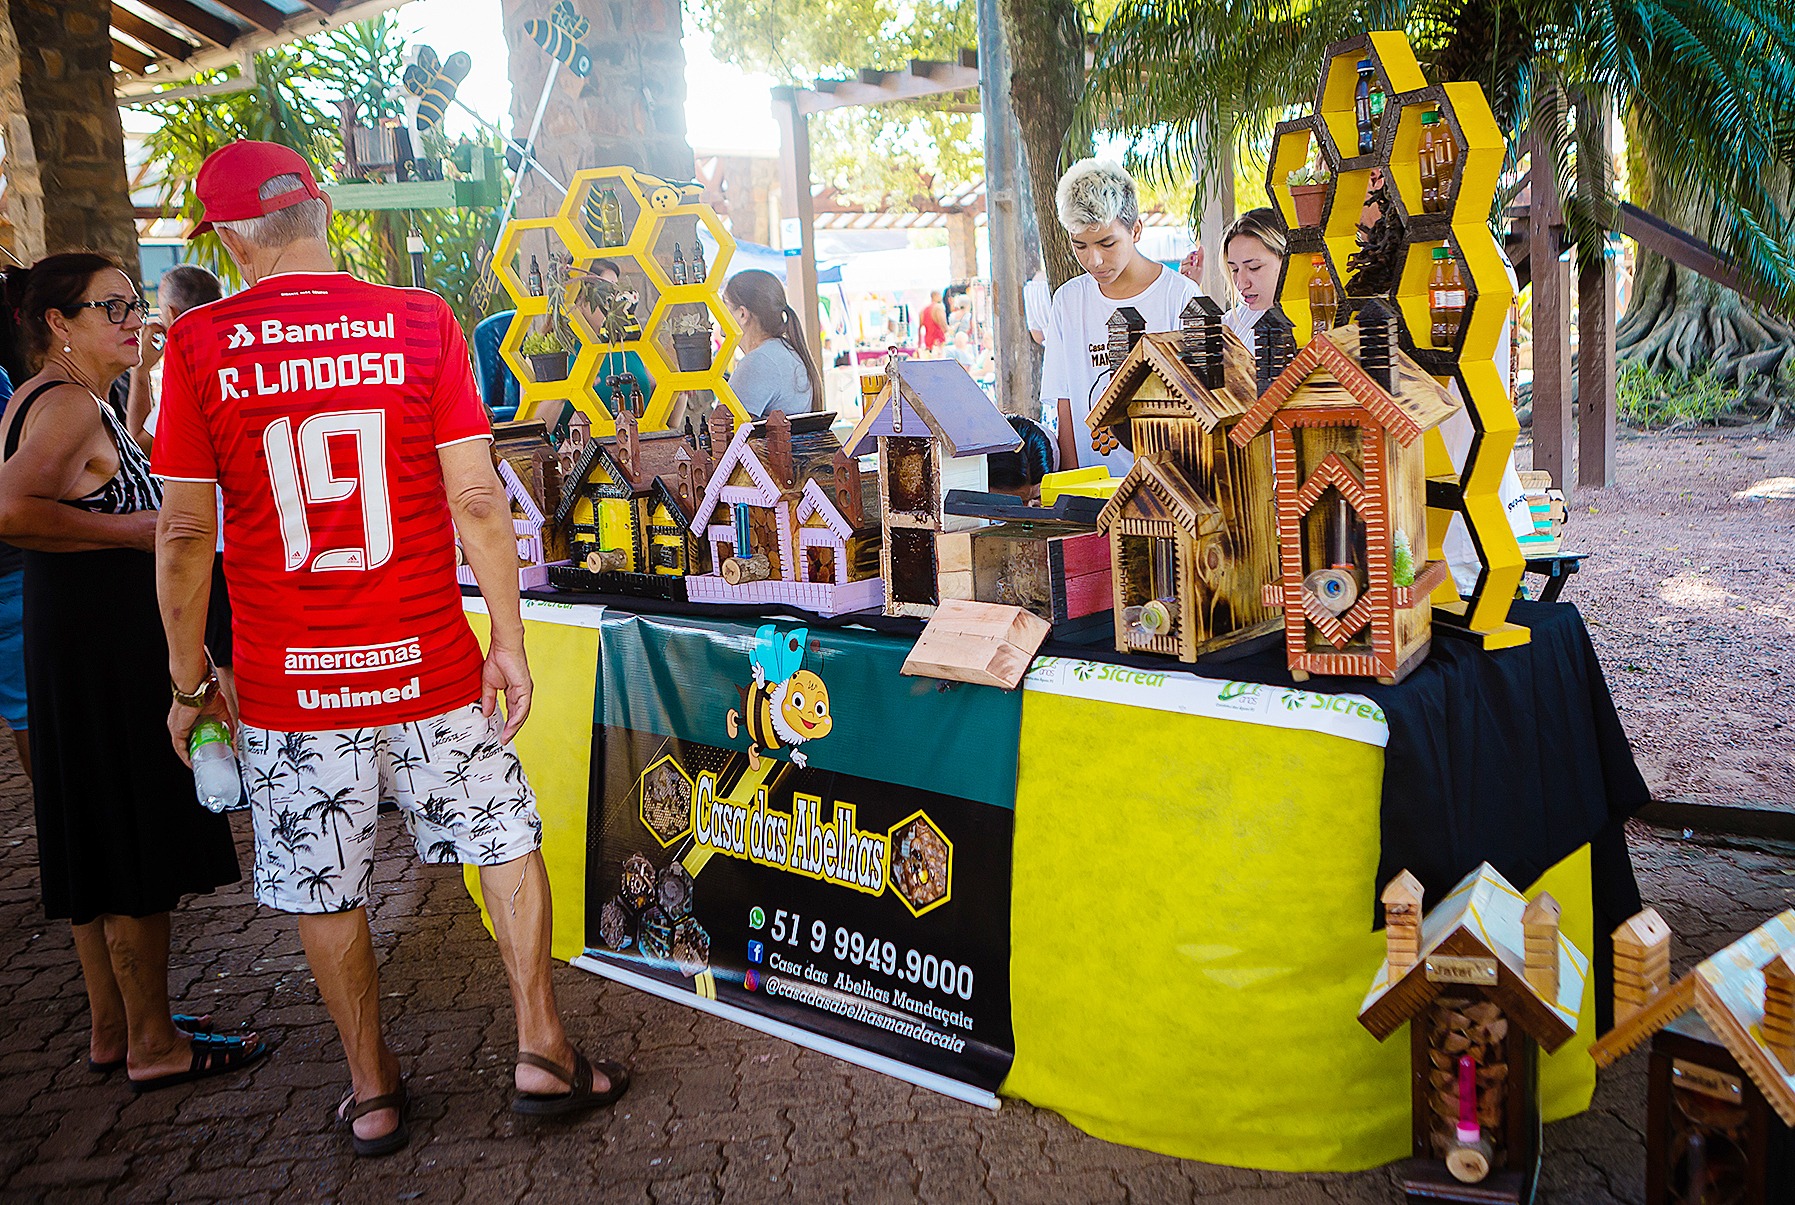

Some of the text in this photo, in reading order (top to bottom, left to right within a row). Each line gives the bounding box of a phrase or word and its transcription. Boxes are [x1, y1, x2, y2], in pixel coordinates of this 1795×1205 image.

[261, 313, 394, 344] Banrisul
[1089, 343, 1105, 352] Casa
[218, 353, 405, 401] R. LINDOSO
[263, 408, 393, 572] 19
[284, 643, 422, 671] americanas
[297, 676, 420, 710] Unimed
[696, 774, 885, 891] Casa das Abelhas
[771, 909, 974, 1001] 51 9 9949.9000
[765, 975, 966, 1053] @casadasabelhasmandacaia
[769, 952, 974, 1031] Casa das Abelhas Mandaçaia
